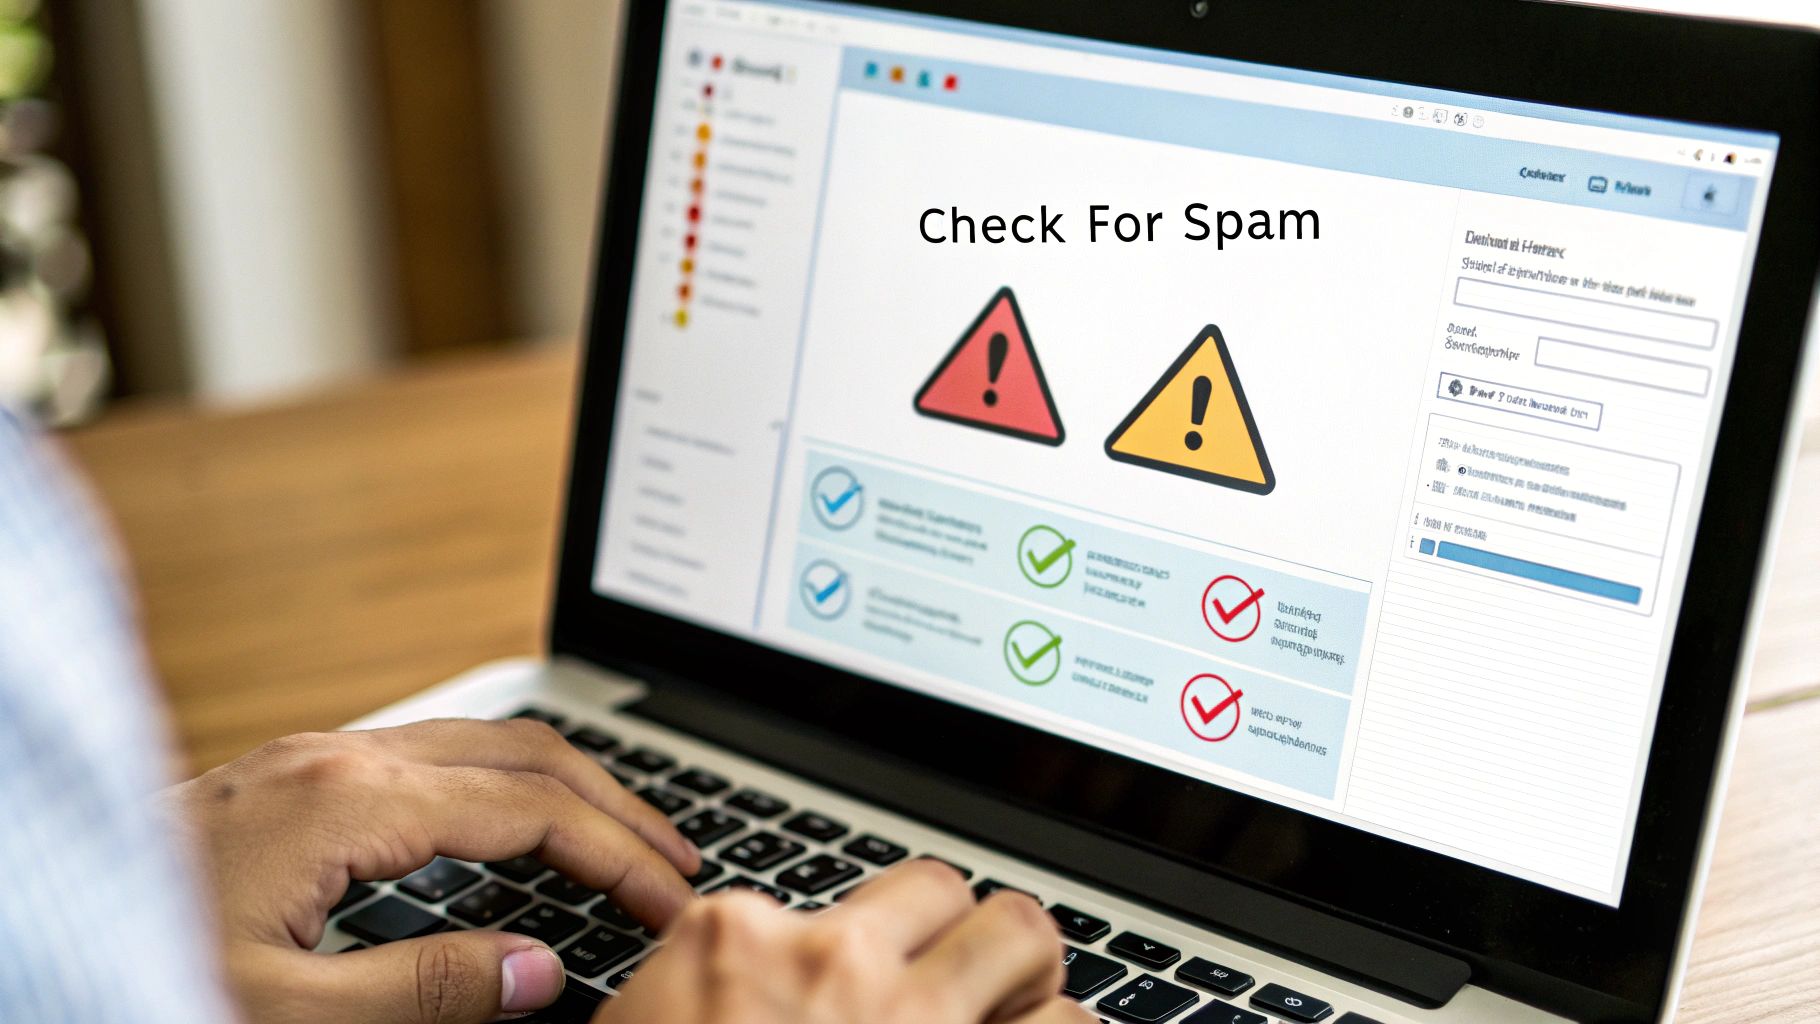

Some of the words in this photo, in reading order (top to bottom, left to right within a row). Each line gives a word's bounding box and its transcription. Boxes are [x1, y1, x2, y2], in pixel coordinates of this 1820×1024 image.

[919, 204, 1066, 245] Check
[1089, 204, 1163, 243] For
[1184, 202, 1321, 251] Spam
